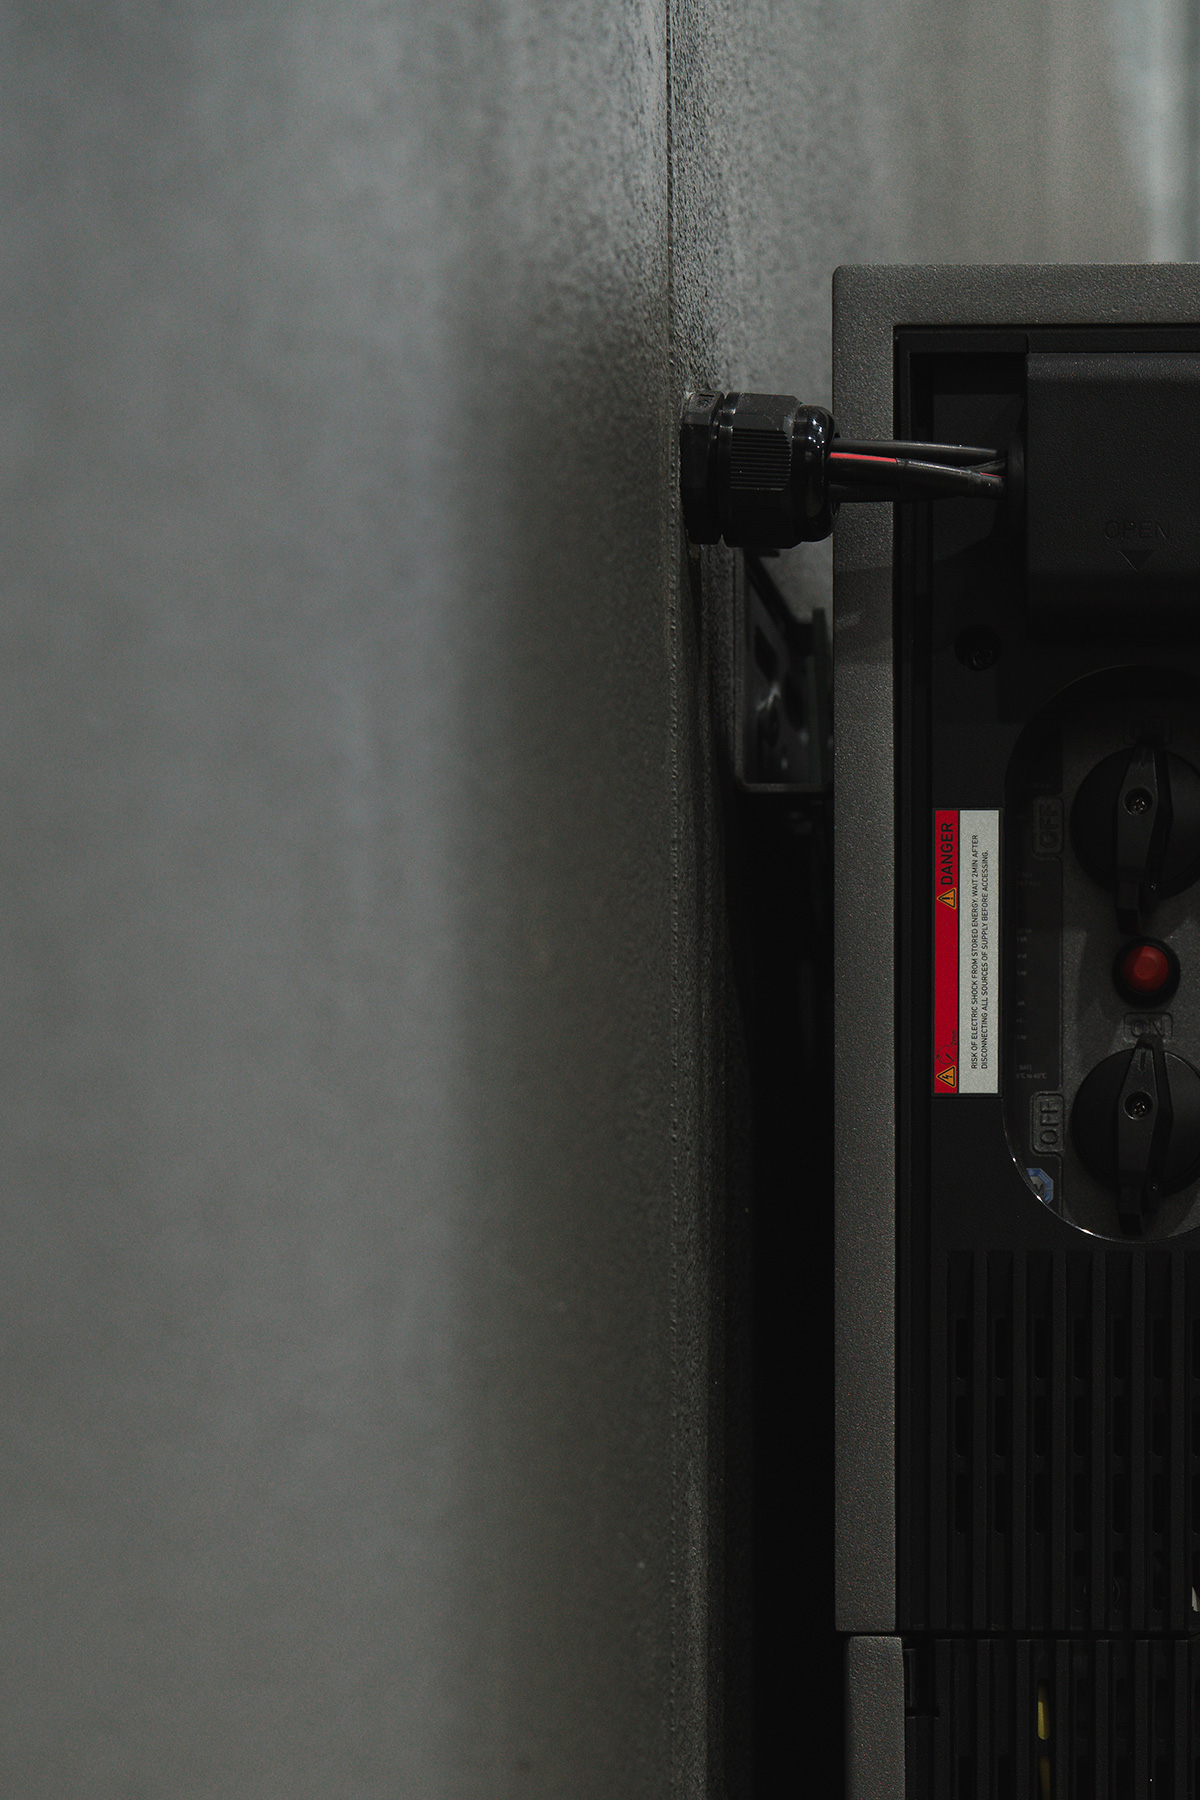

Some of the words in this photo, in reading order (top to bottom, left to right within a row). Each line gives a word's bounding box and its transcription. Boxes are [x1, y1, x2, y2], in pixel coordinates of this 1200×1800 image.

[1104, 520, 1170, 539] OPEN
[1039, 804, 1059, 848] OFF
[940, 823, 954, 886] DANGER
[971, 835, 979, 859] AFTER
[971, 860, 979, 878] 2MIN
[981, 850, 989, 892] ACCESSING.
[971, 879, 979, 897] WAIT
[981, 893, 989, 922] BEFORE
[971, 929, 979, 957] STORED
[981, 923, 989, 950] SUPPLY
[971, 959, 979, 979] FROM
[981, 951, 989, 962] OF
[981, 963, 989, 996] SOURCES
[971, 981, 979, 1005] SHOCK
[981, 998, 989, 1012] ALL
[971, 1007, 979, 1040] ELECTRIC
[971, 1042, 979, 1051] OF
[981, 1013, 989, 1070] DISCONNECTING
[971, 1053, 979, 1070] RISK
[1039, 1101, 1059, 1146] OFF
